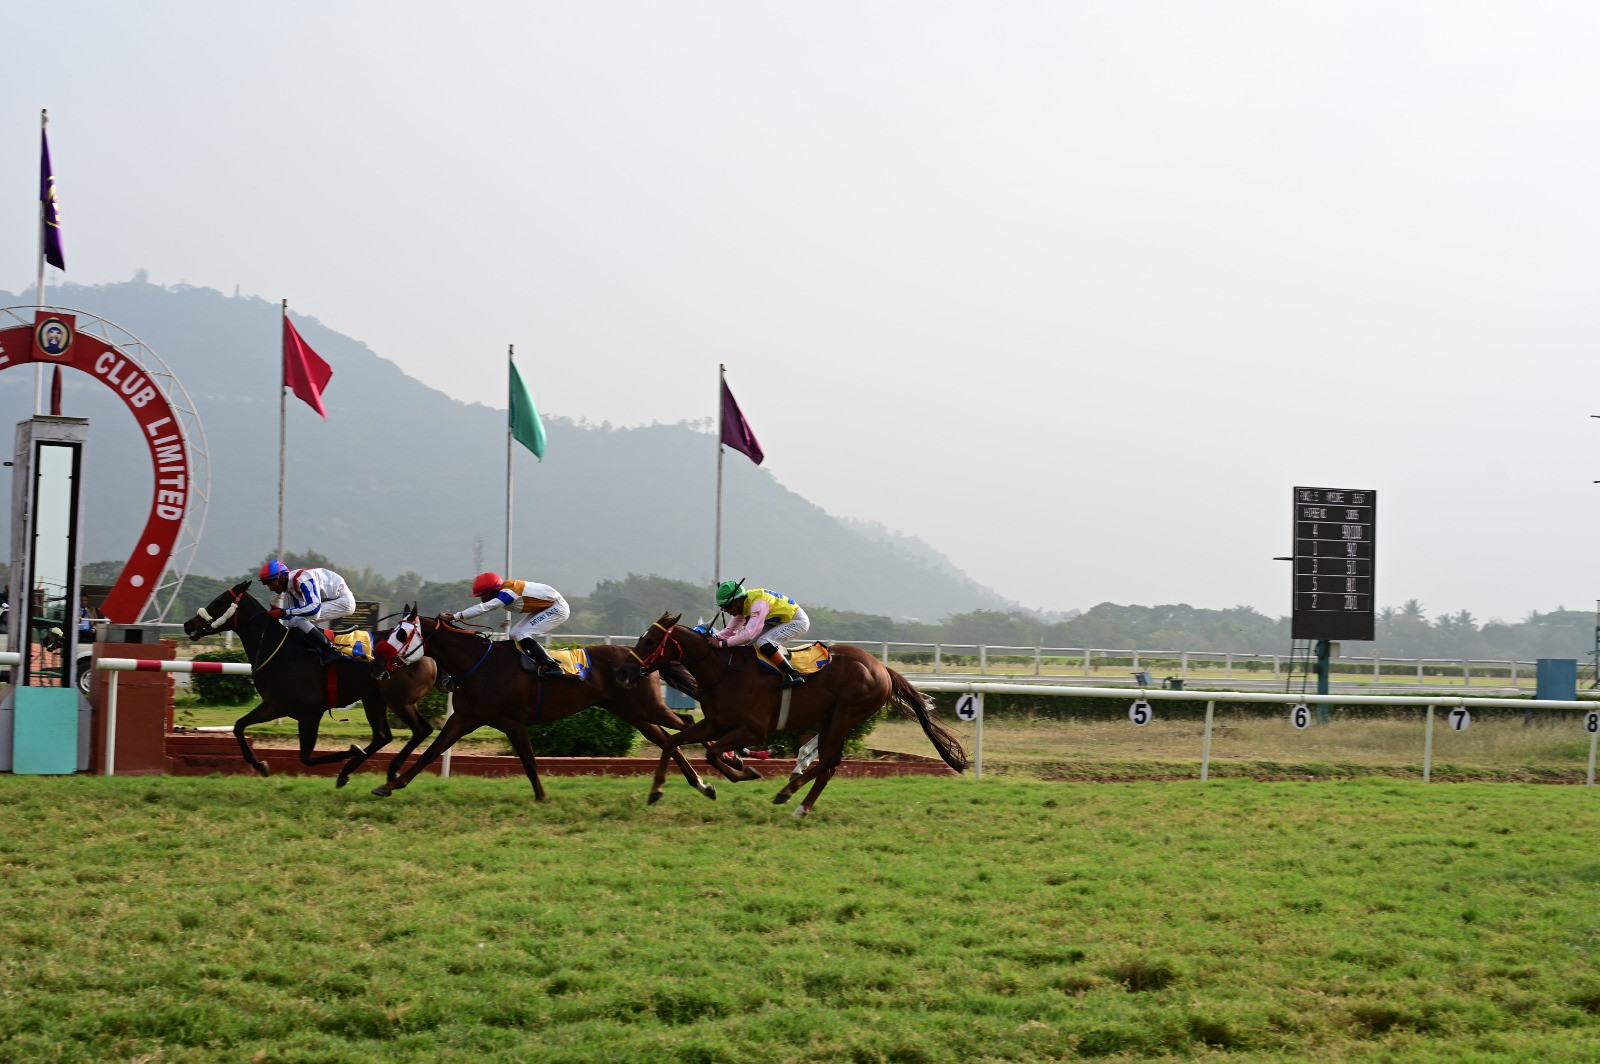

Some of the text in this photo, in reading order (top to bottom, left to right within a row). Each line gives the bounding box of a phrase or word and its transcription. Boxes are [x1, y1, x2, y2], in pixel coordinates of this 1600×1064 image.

[94, 352, 186, 521] CLUB LIMITED
[530, 614, 547, 626] ANTONY
[959, 696, 975, 719] 4
[1133, 703, 1148, 725] 5
[1295, 707, 1307, 728] 6
[1453, 710, 1467, 730] 7
[1587, 713, 1599, 733] 8
